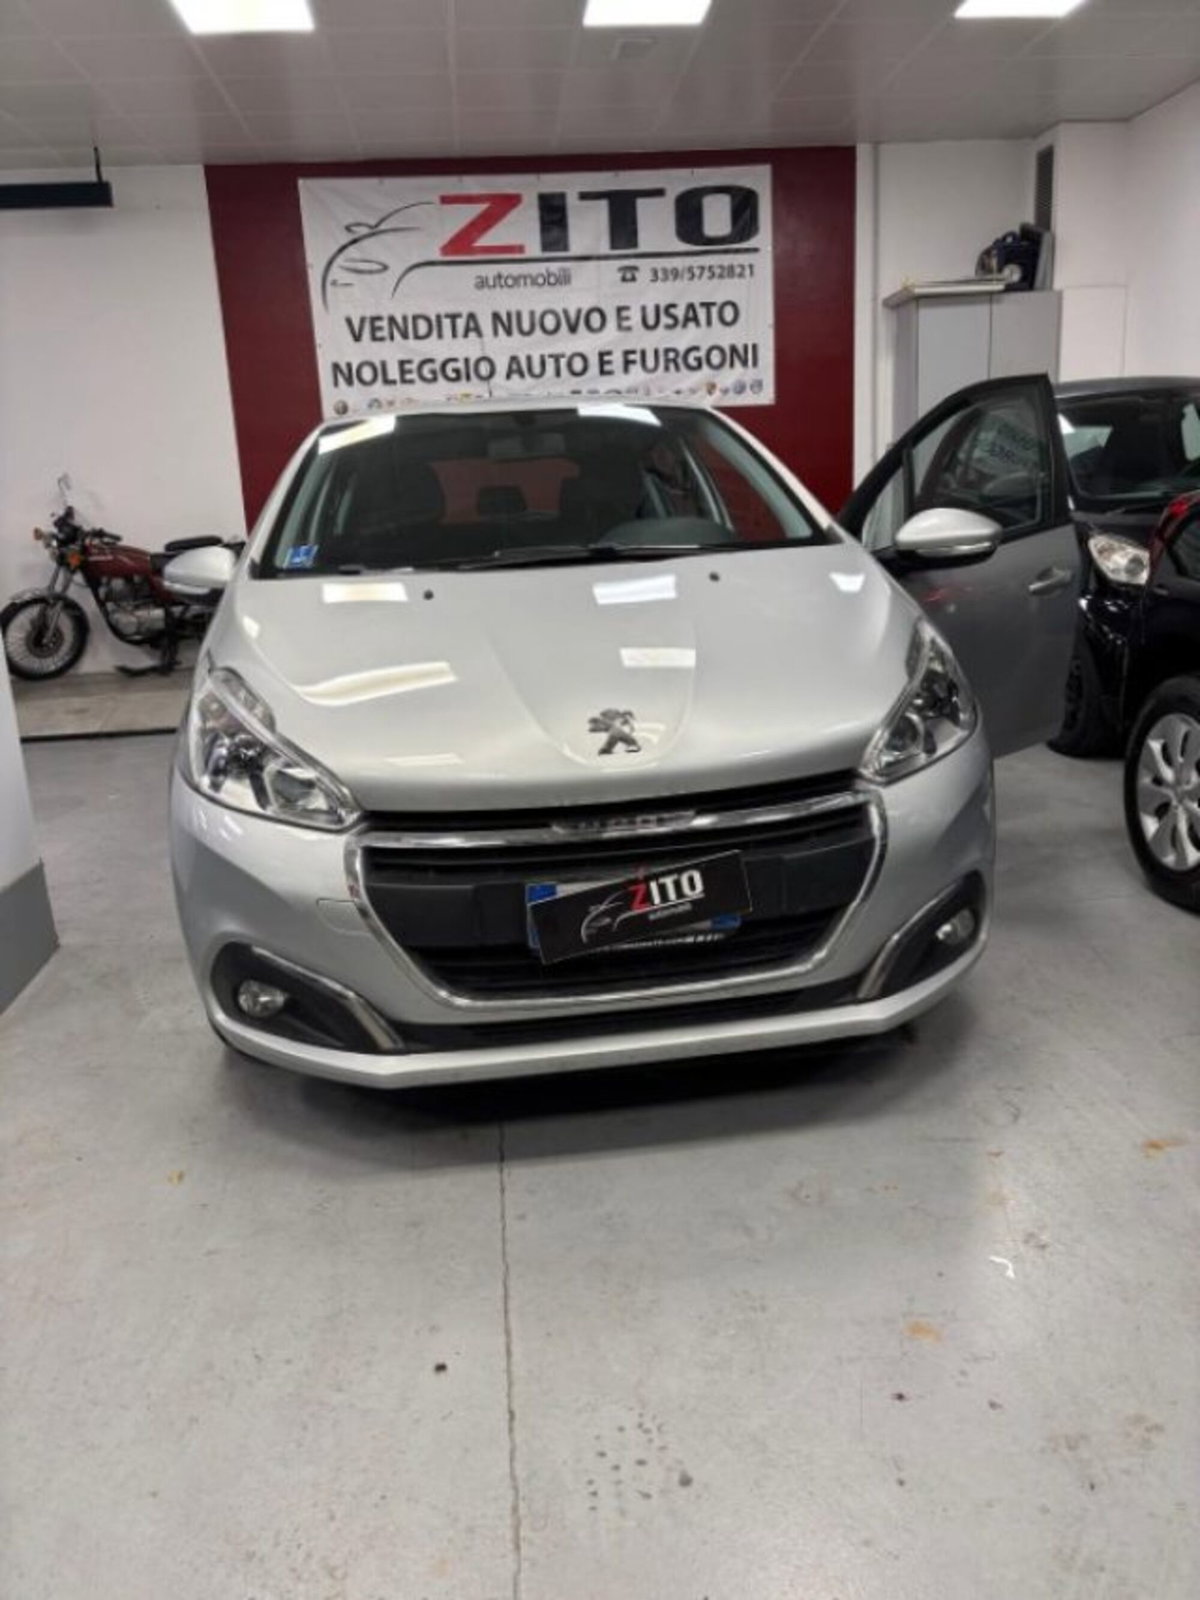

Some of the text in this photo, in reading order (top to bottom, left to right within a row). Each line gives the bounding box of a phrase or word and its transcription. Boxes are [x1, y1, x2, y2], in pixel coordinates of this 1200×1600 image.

[439, 184, 760, 256] ZITO
[474, 268, 572, 290] automobili
[649, 264, 756, 283] 339/5752821
[345, 300, 740, 343] VENDITA NUOVO E USATO
[331, 343, 759, 388] NOLEGGIO AUTO E FURGONI
[629, 868, 704, 913] ZITO
